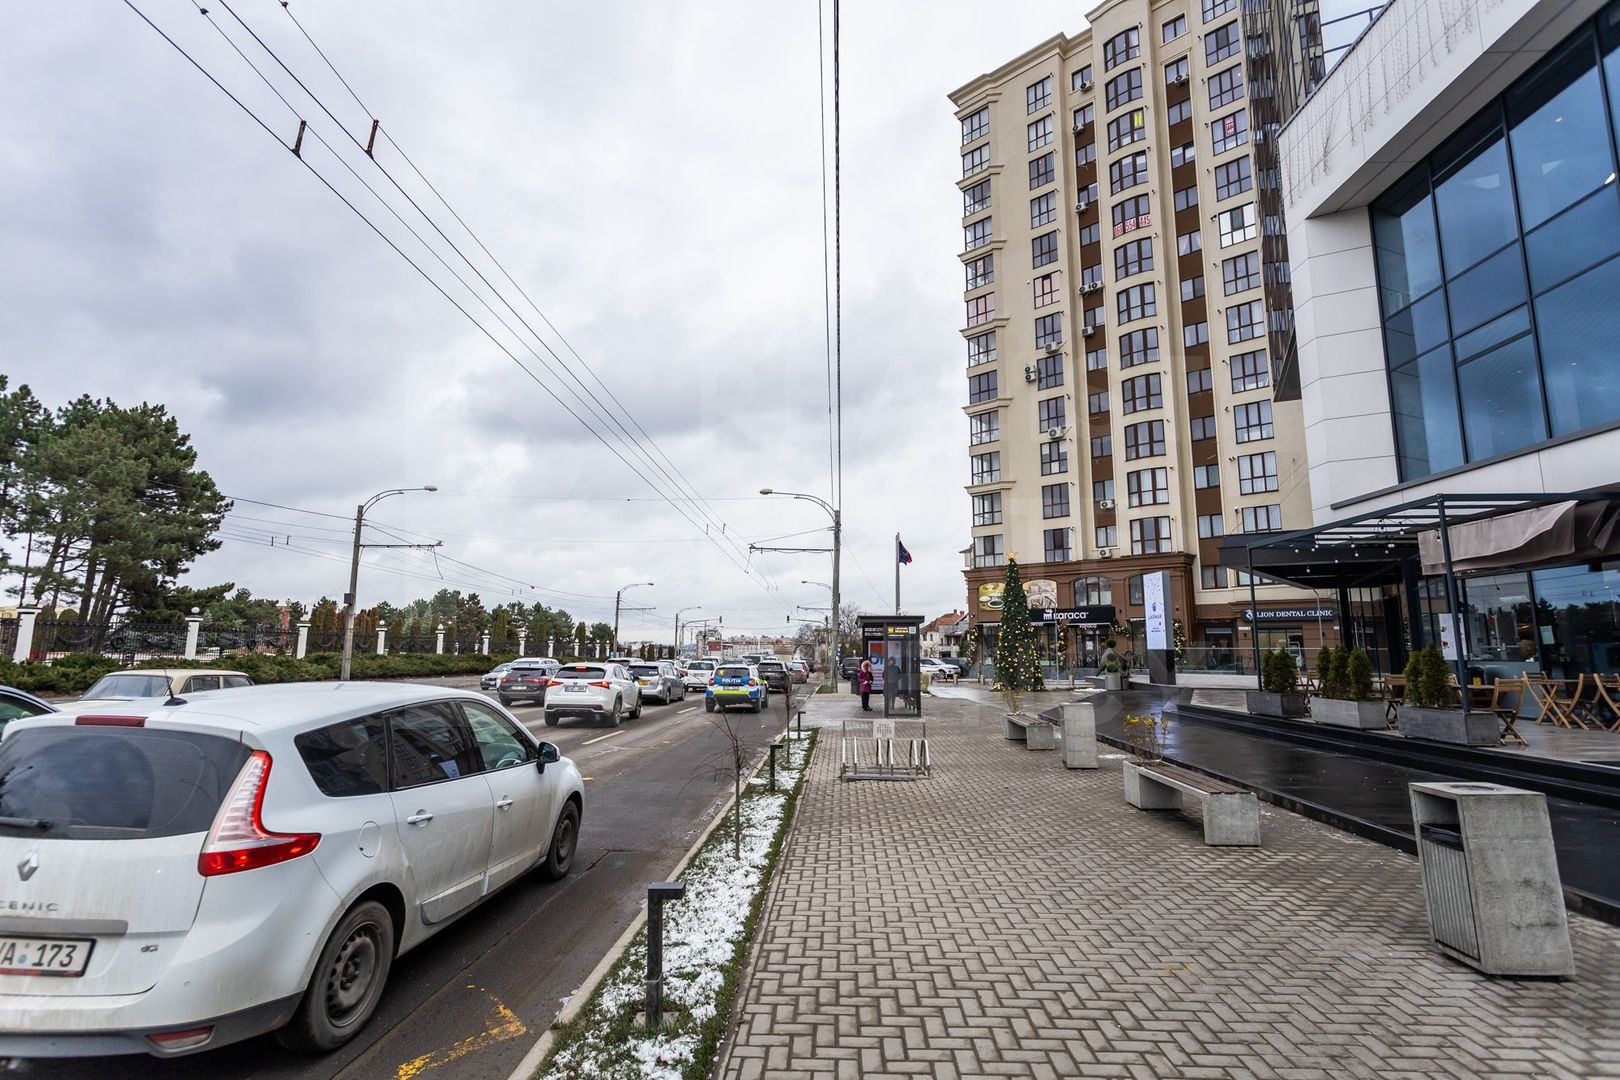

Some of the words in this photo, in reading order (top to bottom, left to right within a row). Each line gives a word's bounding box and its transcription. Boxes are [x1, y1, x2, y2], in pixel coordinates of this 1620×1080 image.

[1053, 611, 1087, 619] karaca
[1276, 610, 1306, 618] DENTAL
[1306, 609, 1334, 617] CLINIC
[32, 944, 78, 968] 173
